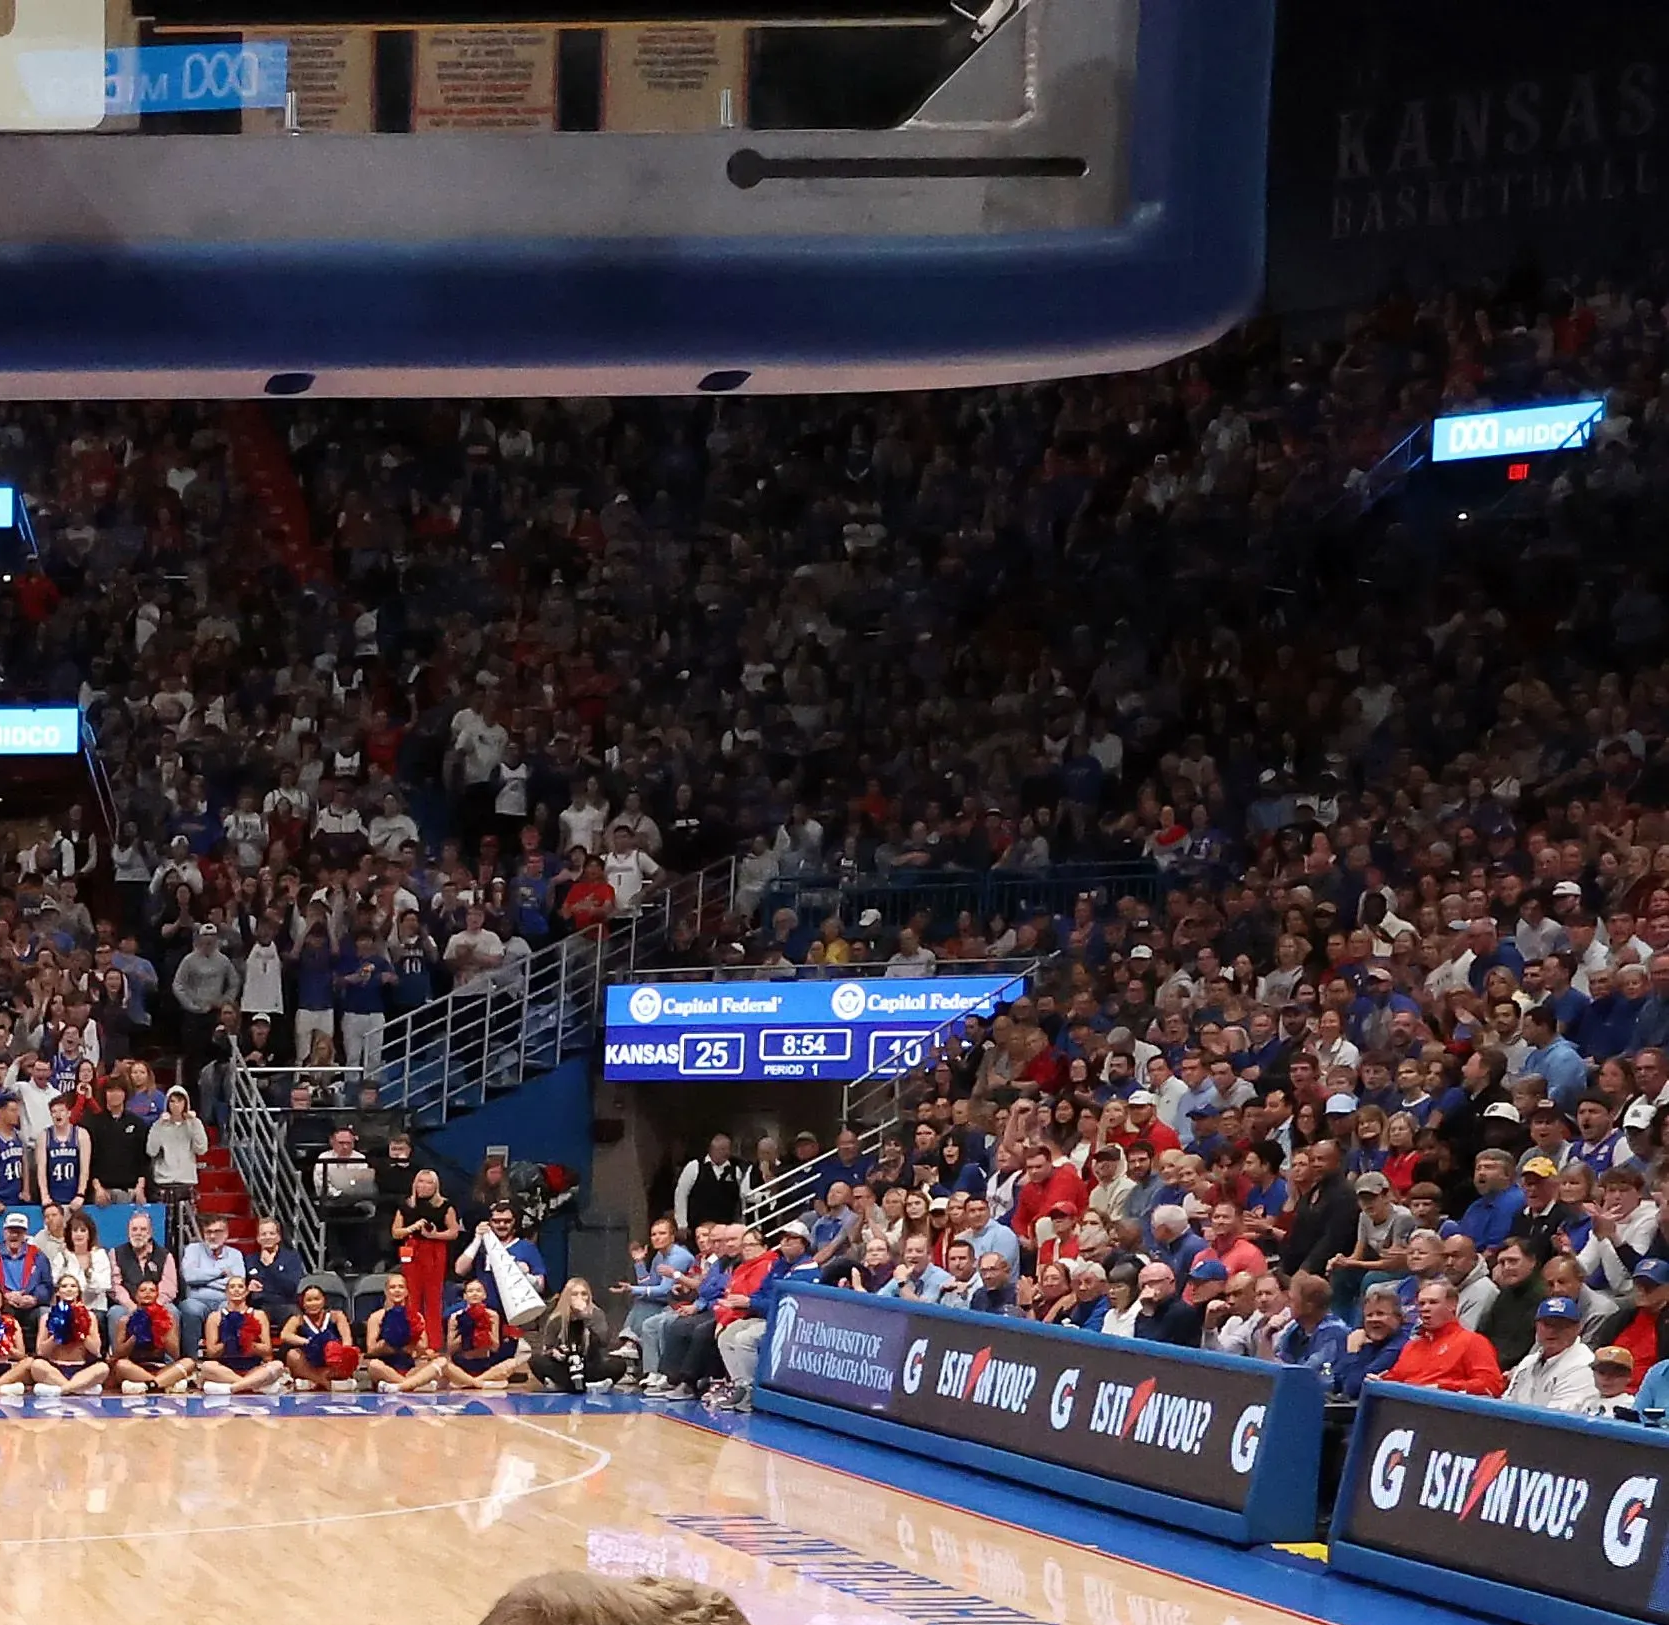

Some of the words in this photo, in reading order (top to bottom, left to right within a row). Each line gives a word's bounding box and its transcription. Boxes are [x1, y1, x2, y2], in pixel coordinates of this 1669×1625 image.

[1335, 62, 1662, 179] KANSAS
[1330, 150, 1664, 239] BASKETBALL
[663, 996, 717, 1017] Capitol
[718, 996, 780, 1014] Federal
[867, 993, 925, 1013] Capitol
[605, 1043, 679, 1065] KANSAS
[695, 1041, 728, 1067] 25
[783, 1034, 827, 1055] 8:54
[763, 1063, 804, 1076] PERIOD
[811, 1063, 819, 1077] 1
[52, 1162, 74, 1181] 40
[795, 1318, 814, 1343] THE
[813, 1321, 870, 1355] UNIVERSITY
[867, 1335, 883, 1358] OF
[789, 1345, 823, 1375] KANSAS
[823, 1352, 858, 1382] HEALTH
[858, 1359, 894, 1391] SYSTEM
[903, 1339, 928, 1395] G
[1050, 1368, 1080, 1430] G
[1231, 1404, 1266, 1473] G
[1370, 1429, 1415, 1510] G
[1513, 1468, 1590, 1540] YOU?
[1603, 1476, 1659, 1568] G
